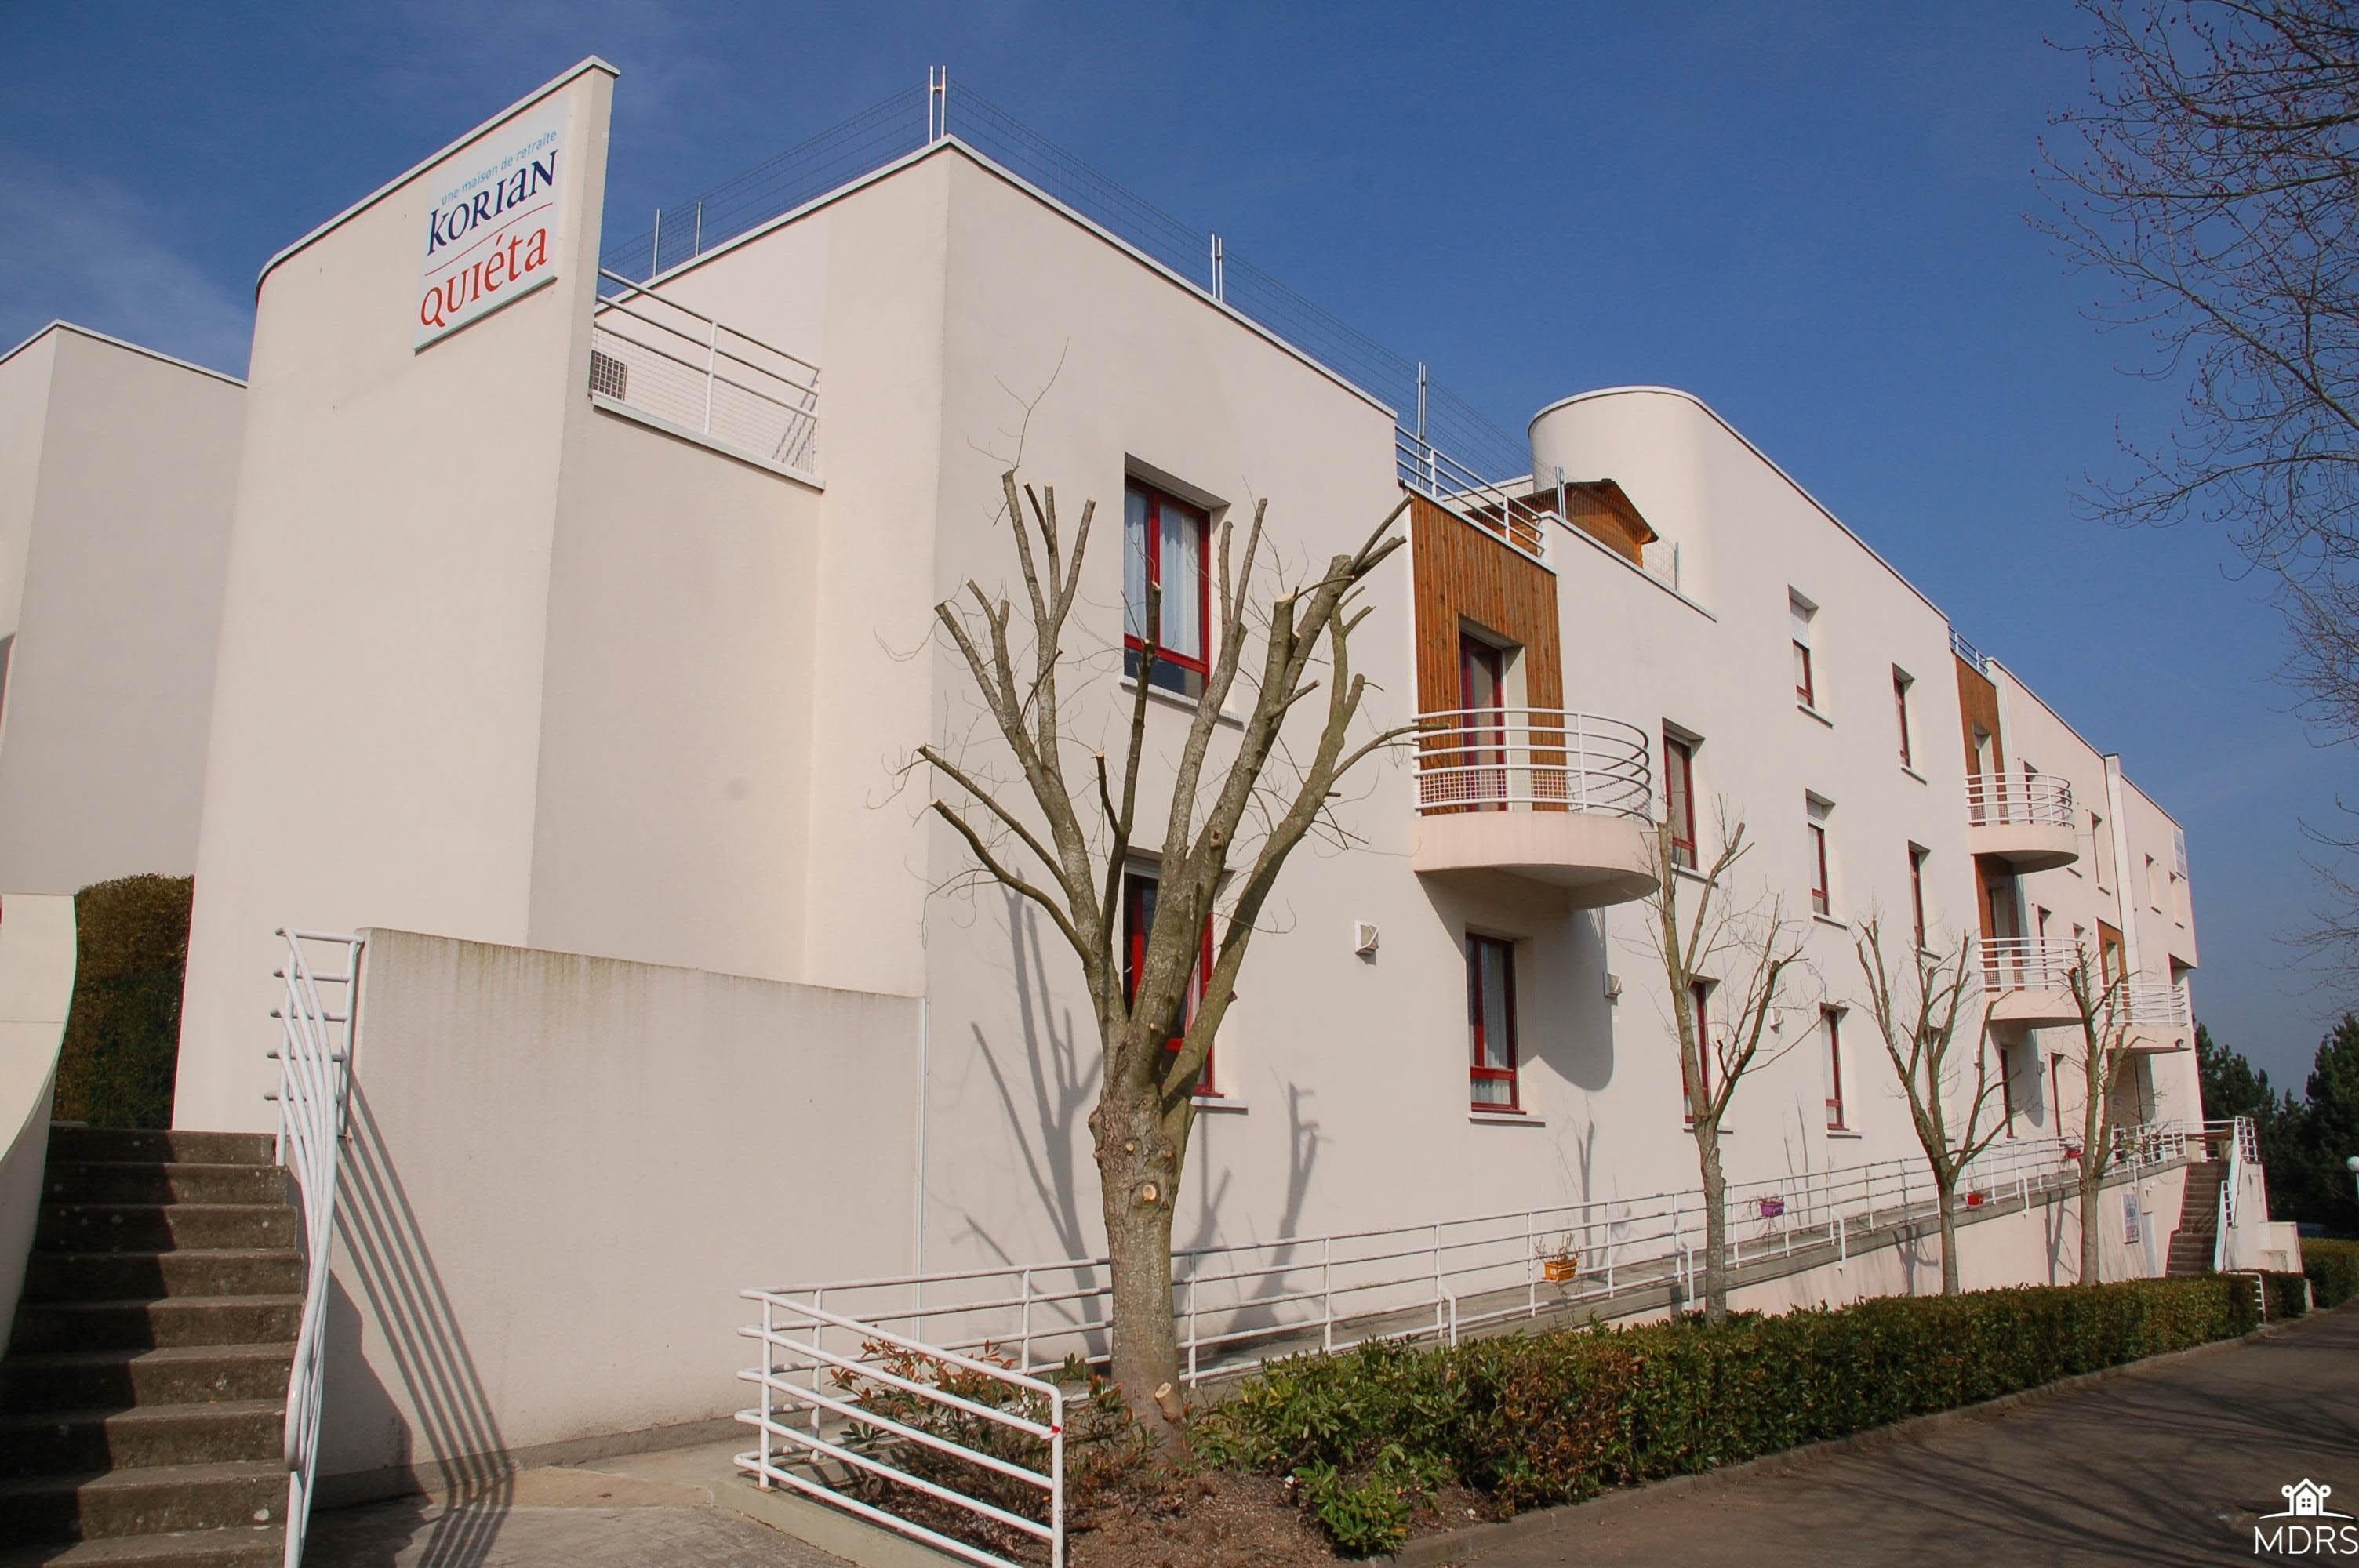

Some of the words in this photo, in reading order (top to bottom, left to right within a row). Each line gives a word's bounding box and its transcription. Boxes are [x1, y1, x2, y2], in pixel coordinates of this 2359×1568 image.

[442, 187, 459, 205] une
[462, 165, 499, 194] maison
[501, 156, 514, 170] de
[516, 131, 558, 162] retraite
